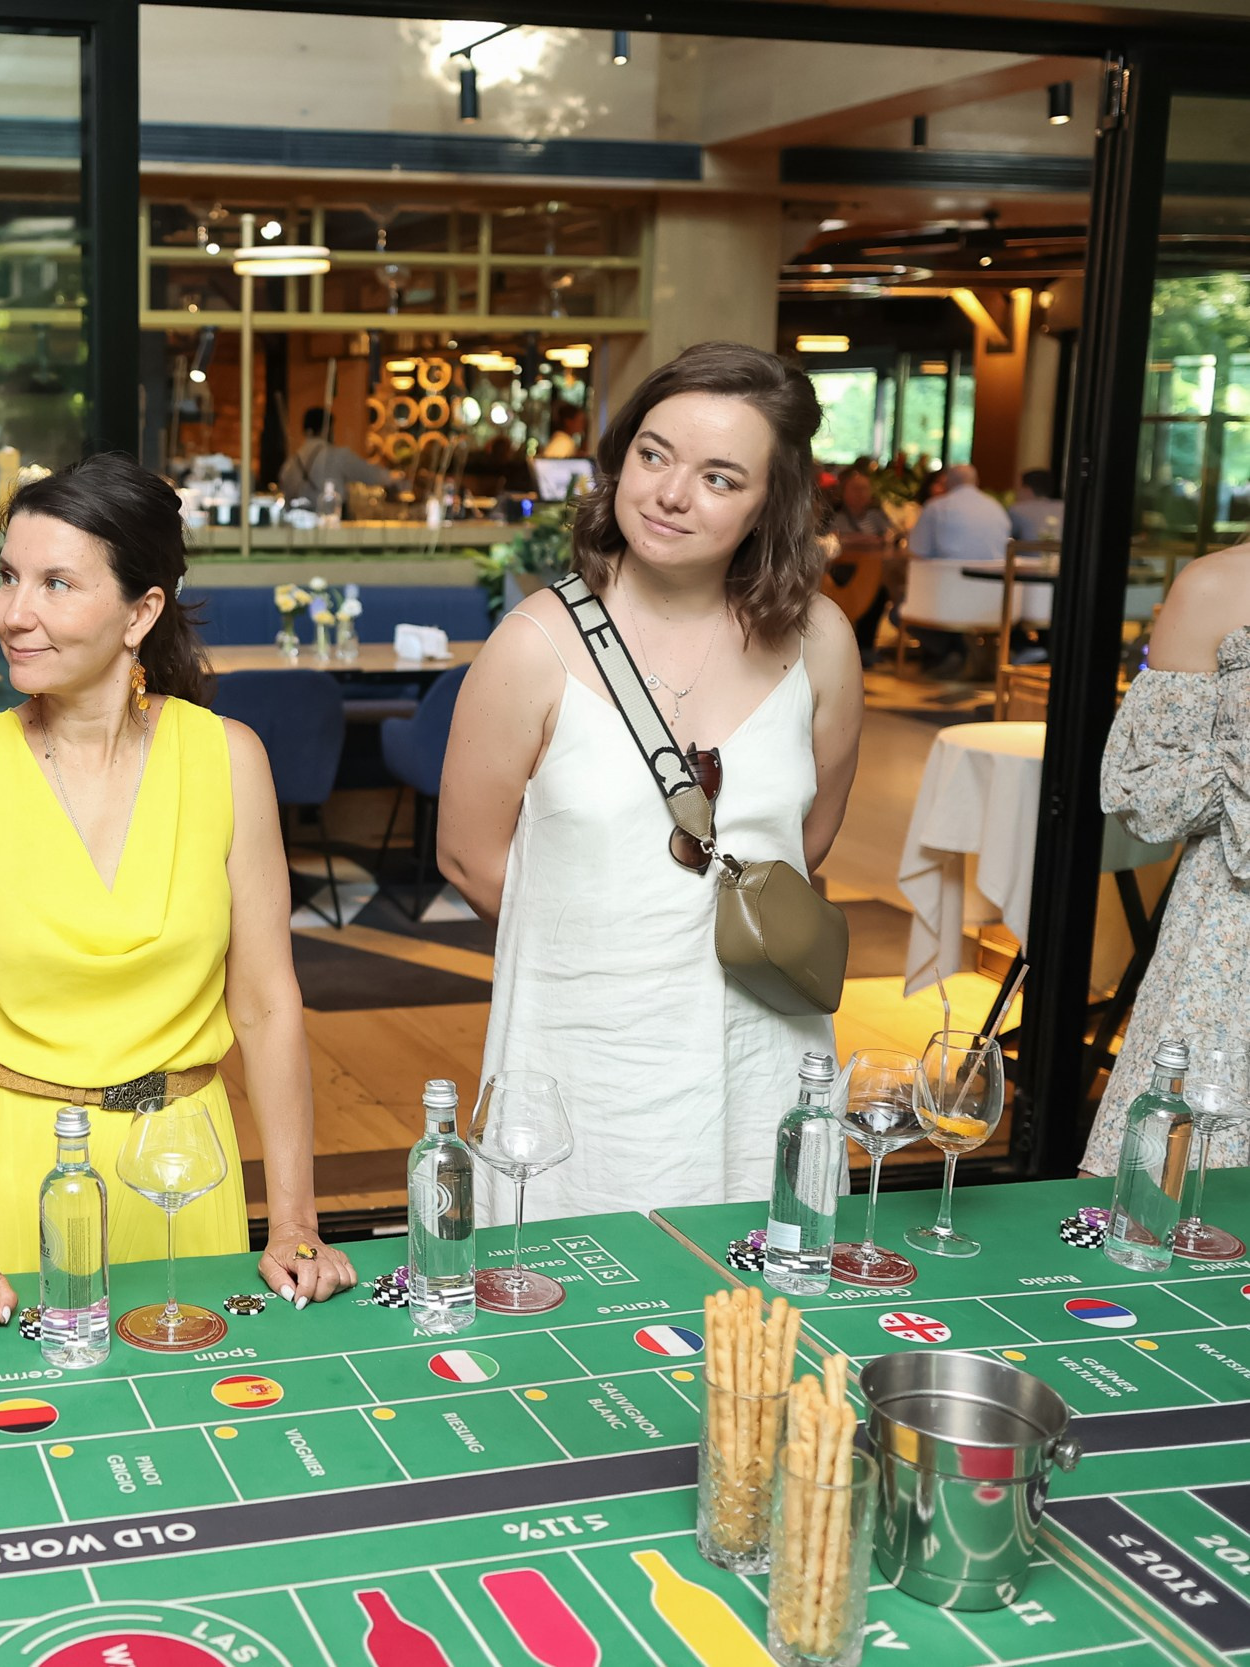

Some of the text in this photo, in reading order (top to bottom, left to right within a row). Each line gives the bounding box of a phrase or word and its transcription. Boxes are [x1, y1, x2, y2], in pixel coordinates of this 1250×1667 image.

[487, 1240, 589, 1258] x4 COUNTRY
[582, 1254, 607, 1265] x3
[598, 1269, 624, 1280] x2
[1018, 1274, 1083, 1287] Russia
[597, 1299, 671, 1315] France
[827, 1288, 912, 1301] Georgia
[193, 1347, 258, 1362] Spain
[1057, 1355, 1122, 1398] VELTLINER
[1081, 1357, 1139, 1393] GRÜNER
[587, 1398, 627, 1430] BLANC
[598, 1381, 664, 1439] SAUVIGNON
[442, 1412, 485, 1454] RIESLING
[284, 1428, 326, 1479] VIOGNIER
[107, 1454, 137, 1494] GRIGIO
[134, 1455, 163, 1486] PINOT
[113, 1522, 197, 1548] OLD
[1126, 1550, 1219, 1606] 2013
[190, 1621, 259, 1663] LAS
